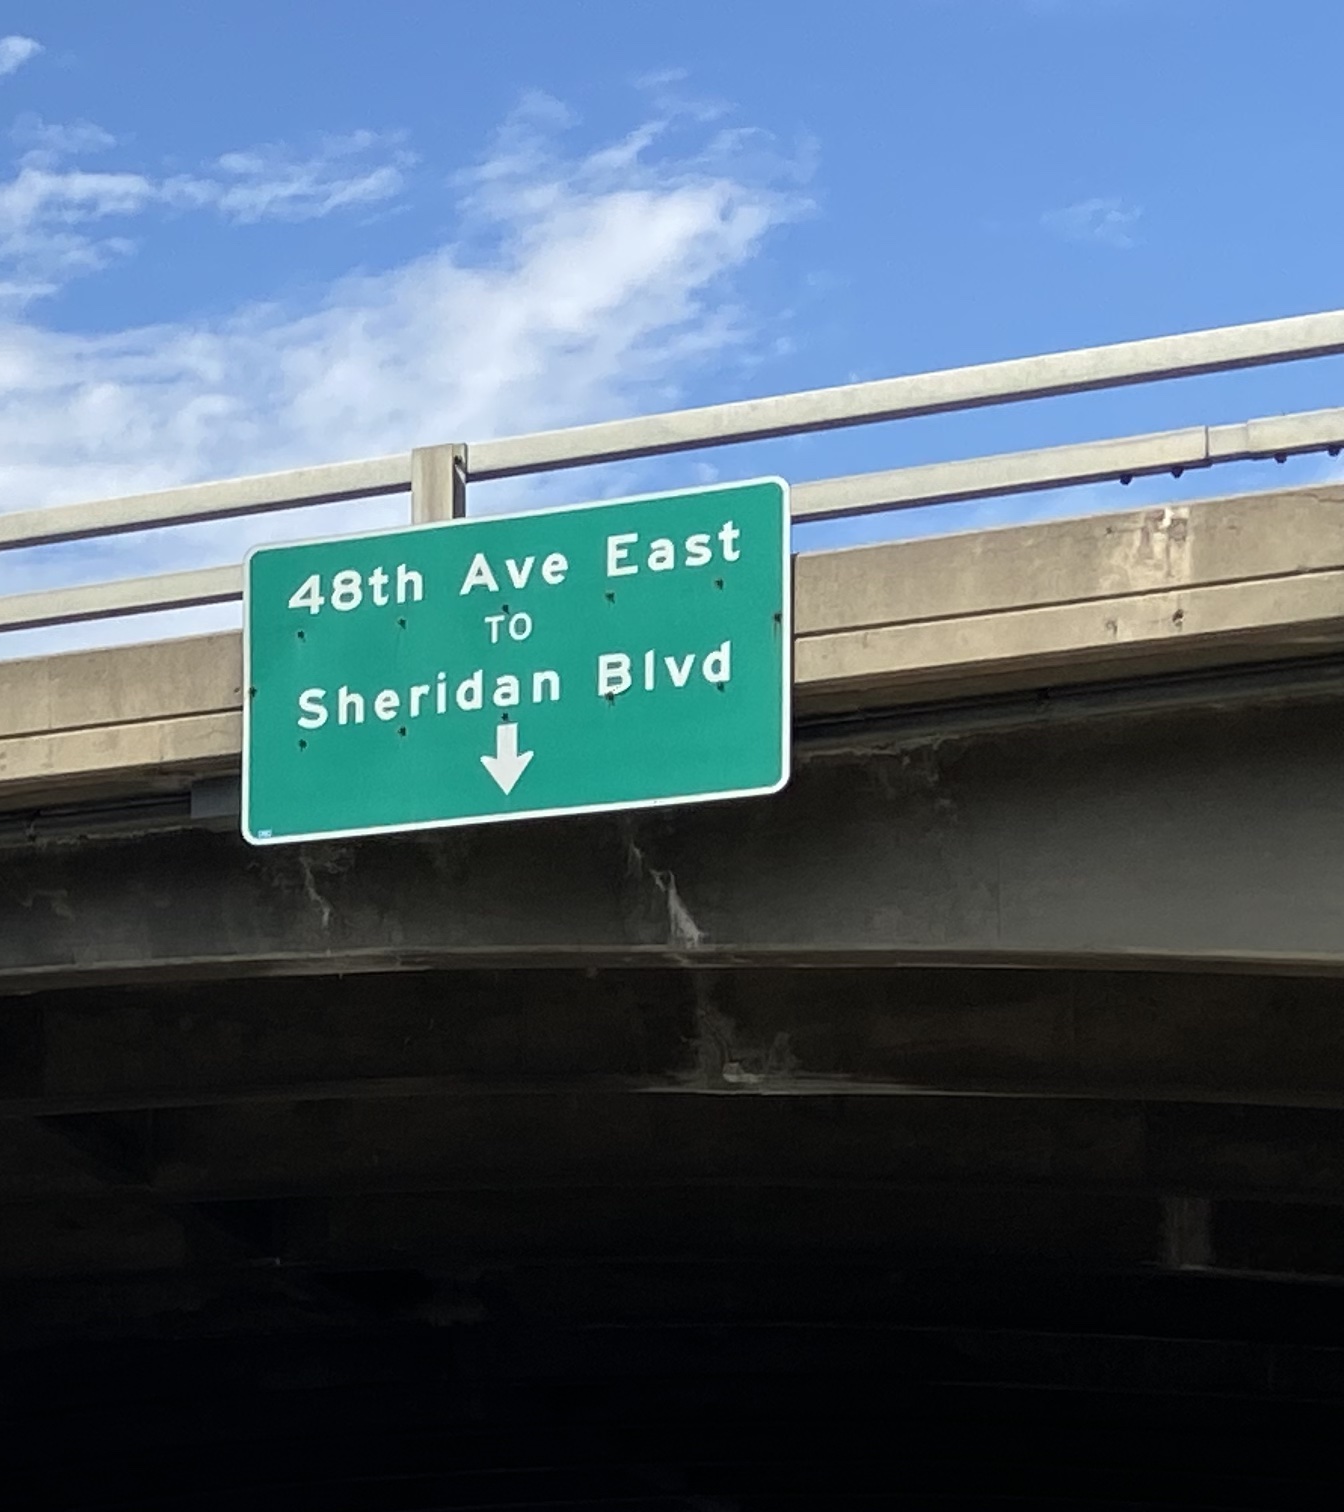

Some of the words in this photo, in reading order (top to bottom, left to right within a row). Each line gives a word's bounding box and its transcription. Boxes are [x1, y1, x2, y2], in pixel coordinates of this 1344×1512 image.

[287, 563, 424, 615] 48th
[460, 552, 569, 596] Ave
[605, 520, 741, 577] East
[484, 612, 533, 644] TO
[297, 669, 561, 729] Sheridan
[597, 640, 732, 697] Blvd
